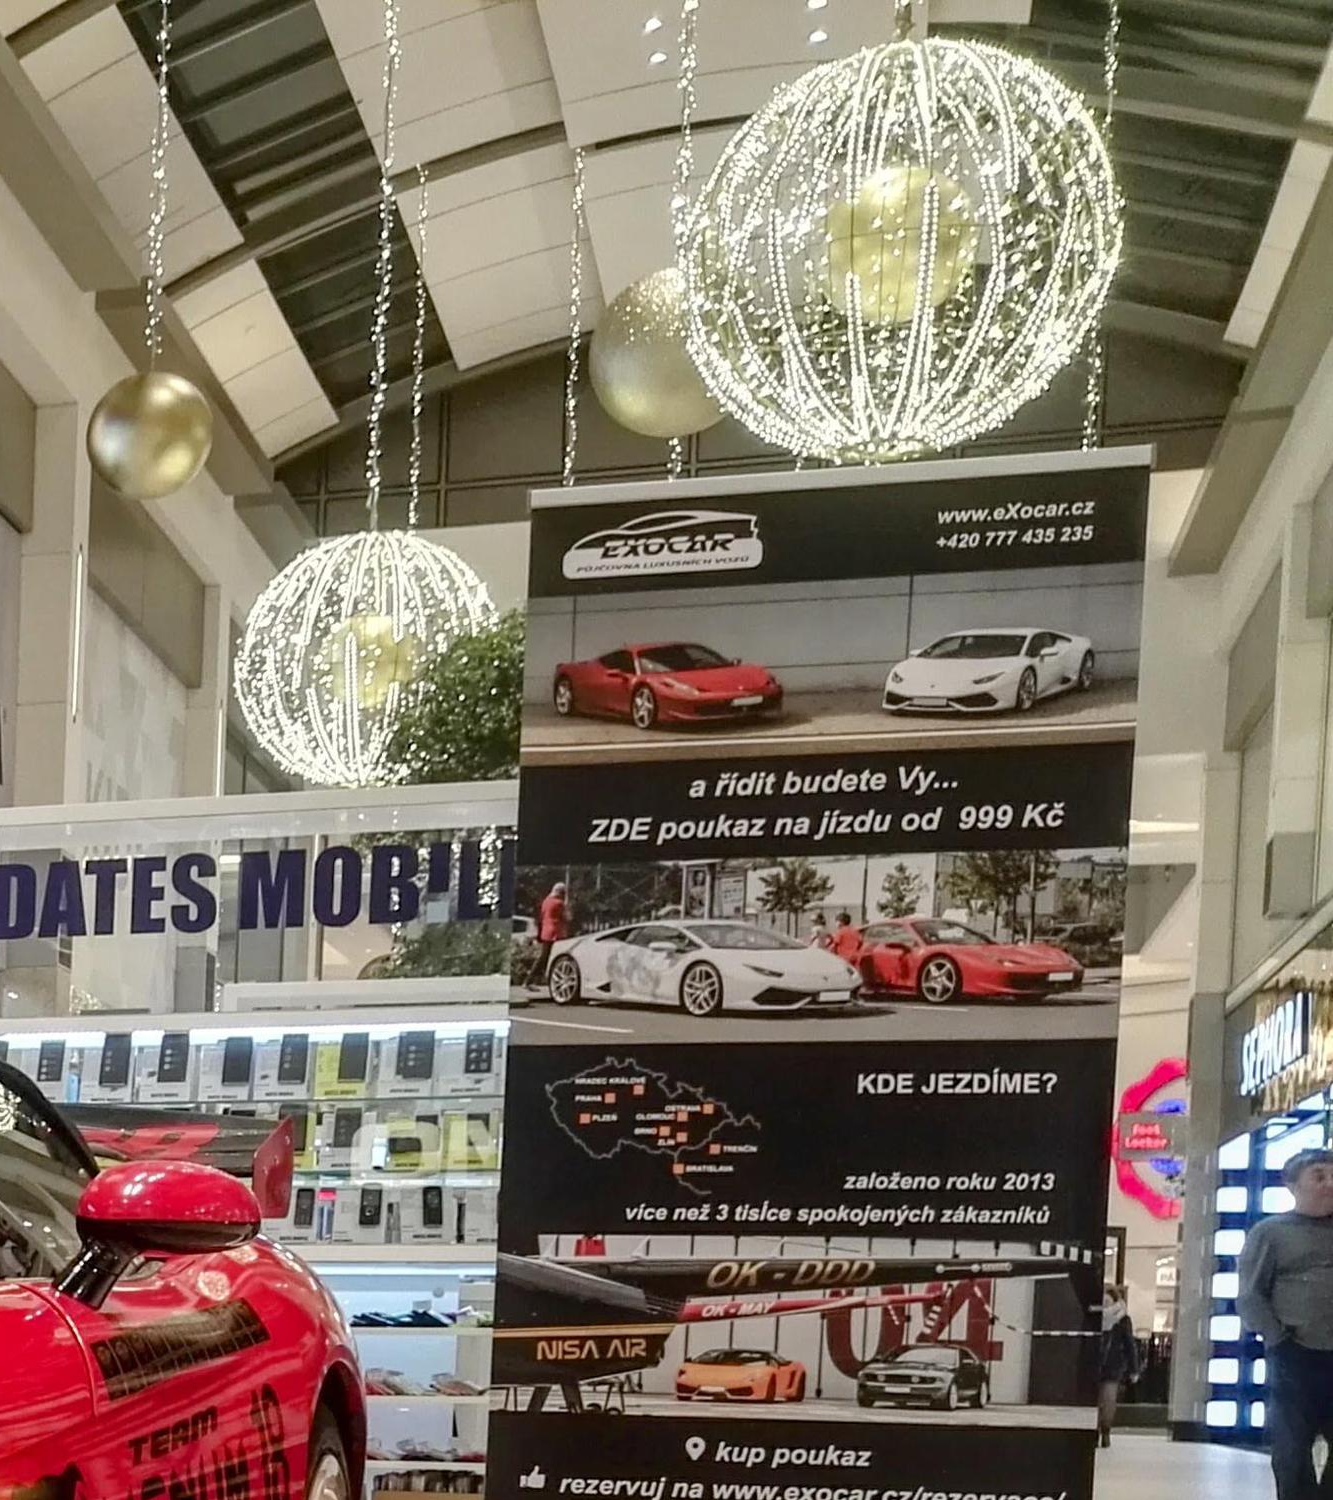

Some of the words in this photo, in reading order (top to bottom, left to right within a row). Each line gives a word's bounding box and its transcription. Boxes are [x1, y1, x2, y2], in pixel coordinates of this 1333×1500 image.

[937, 501, 1096, 524] www.eXocar.cz
[600, 533, 735, 560] EXOCAR
[936, 533, 981, 548] +420
[985, 530, 1018, 547] 777
[1021, 527, 1056, 544] 435
[1060, 525, 1094, 542] 235
[690, 779, 706, 799] a
[715, 769, 775, 797] řídit
[783, 768, 887, 794] budete
[898, 766, 959, 798] Vy...
[589, 818, 651, 844] ZDE
[658, 814, 765, 846] poukaz
[775, 816, 810, 838] na
[815, 808, 895, 844] jízdu
[901, 807, 943, 832] od
[958, 804, 1012, 831] 999
[1021, 801, 1066, 829] Kč
[856, 1074, 914, 1095] KDE
[921, 1070, 1058, 1095] JEZDÍME?
[844, 1171, 941, 1191] založeno
[946, 1173, 996, 1191] roku
[1003, 1172, 1055, 1191] 2013
[625, 1203, 668, 1222] více
[674, 1203, 711, 1222] než
[716, 1205, 728, 1222] 3
[796, 1204, 936, 1226] spokojených
[940, 1203, 1050, 1225] zákazníků
[707, 1260, 767, 1288] OK
[793, 1259, 877, 1286] DDD
[701, 1304, 729, 1317] OK
[537, 1339, 599, 1360] NISA
[606, 1338, 647, 1359] AIR
[128, 1405, 218, 1466] TEAM
[715, 1440, 766, 1467] kup
[773, 1444, 873, 1470] poukaz
[671, 1481, 704, 1500] na
